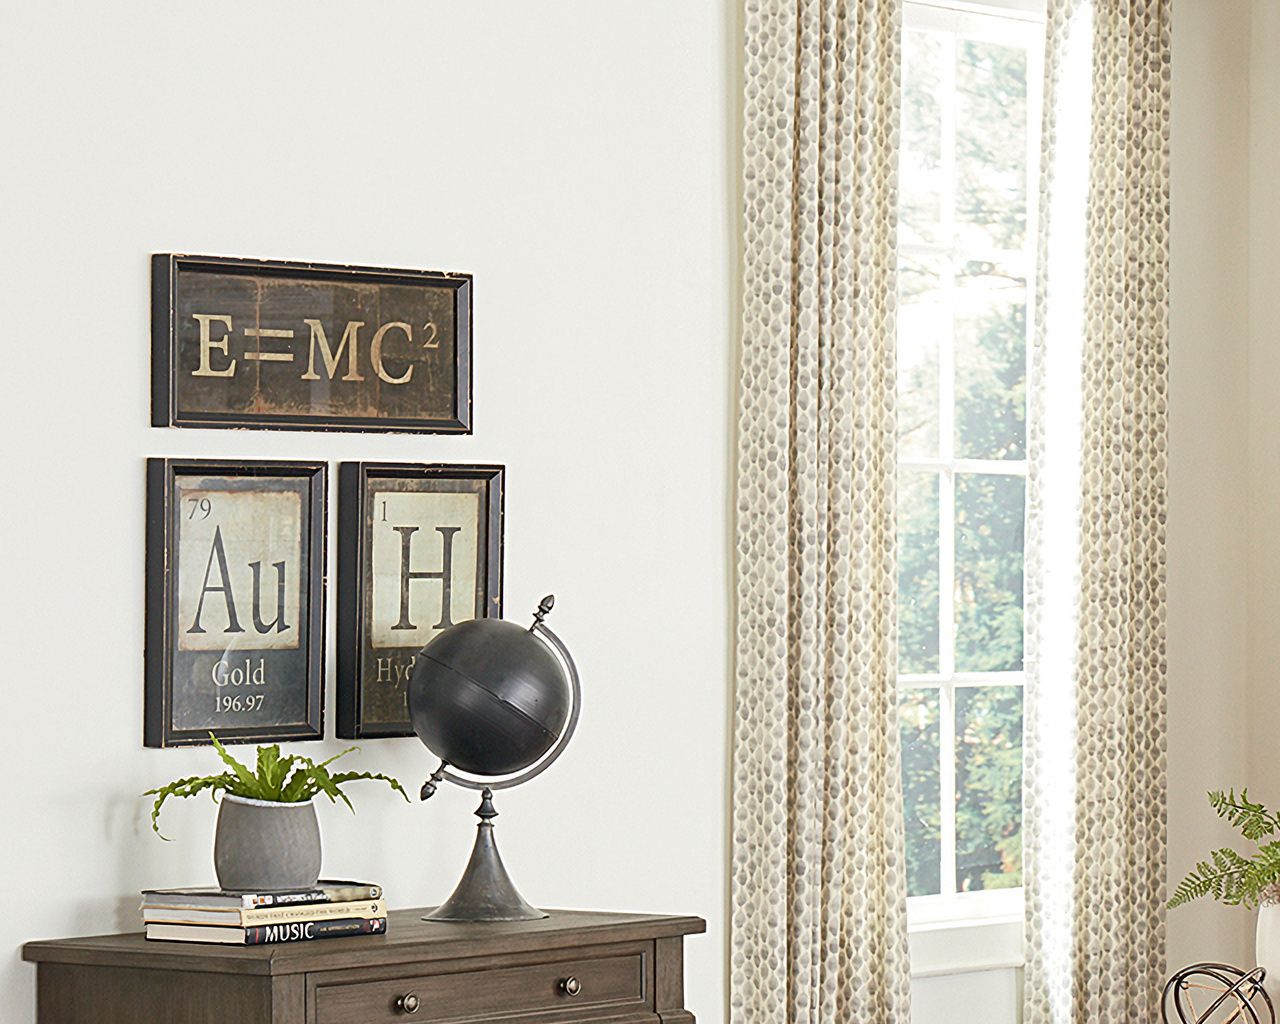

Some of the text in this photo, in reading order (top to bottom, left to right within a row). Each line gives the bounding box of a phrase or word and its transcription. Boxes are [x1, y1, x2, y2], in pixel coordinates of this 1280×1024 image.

[187, 497, 212, 520] 79
[379, 500, 388, 522] 1
[186, 524, 291, 635] Au
[390, 526, 463, 631] H
[212, 659, 266, 687] Gold
[215, 695, 264, 712] 196.97
[265, 922, 315, 942] MUSIC
